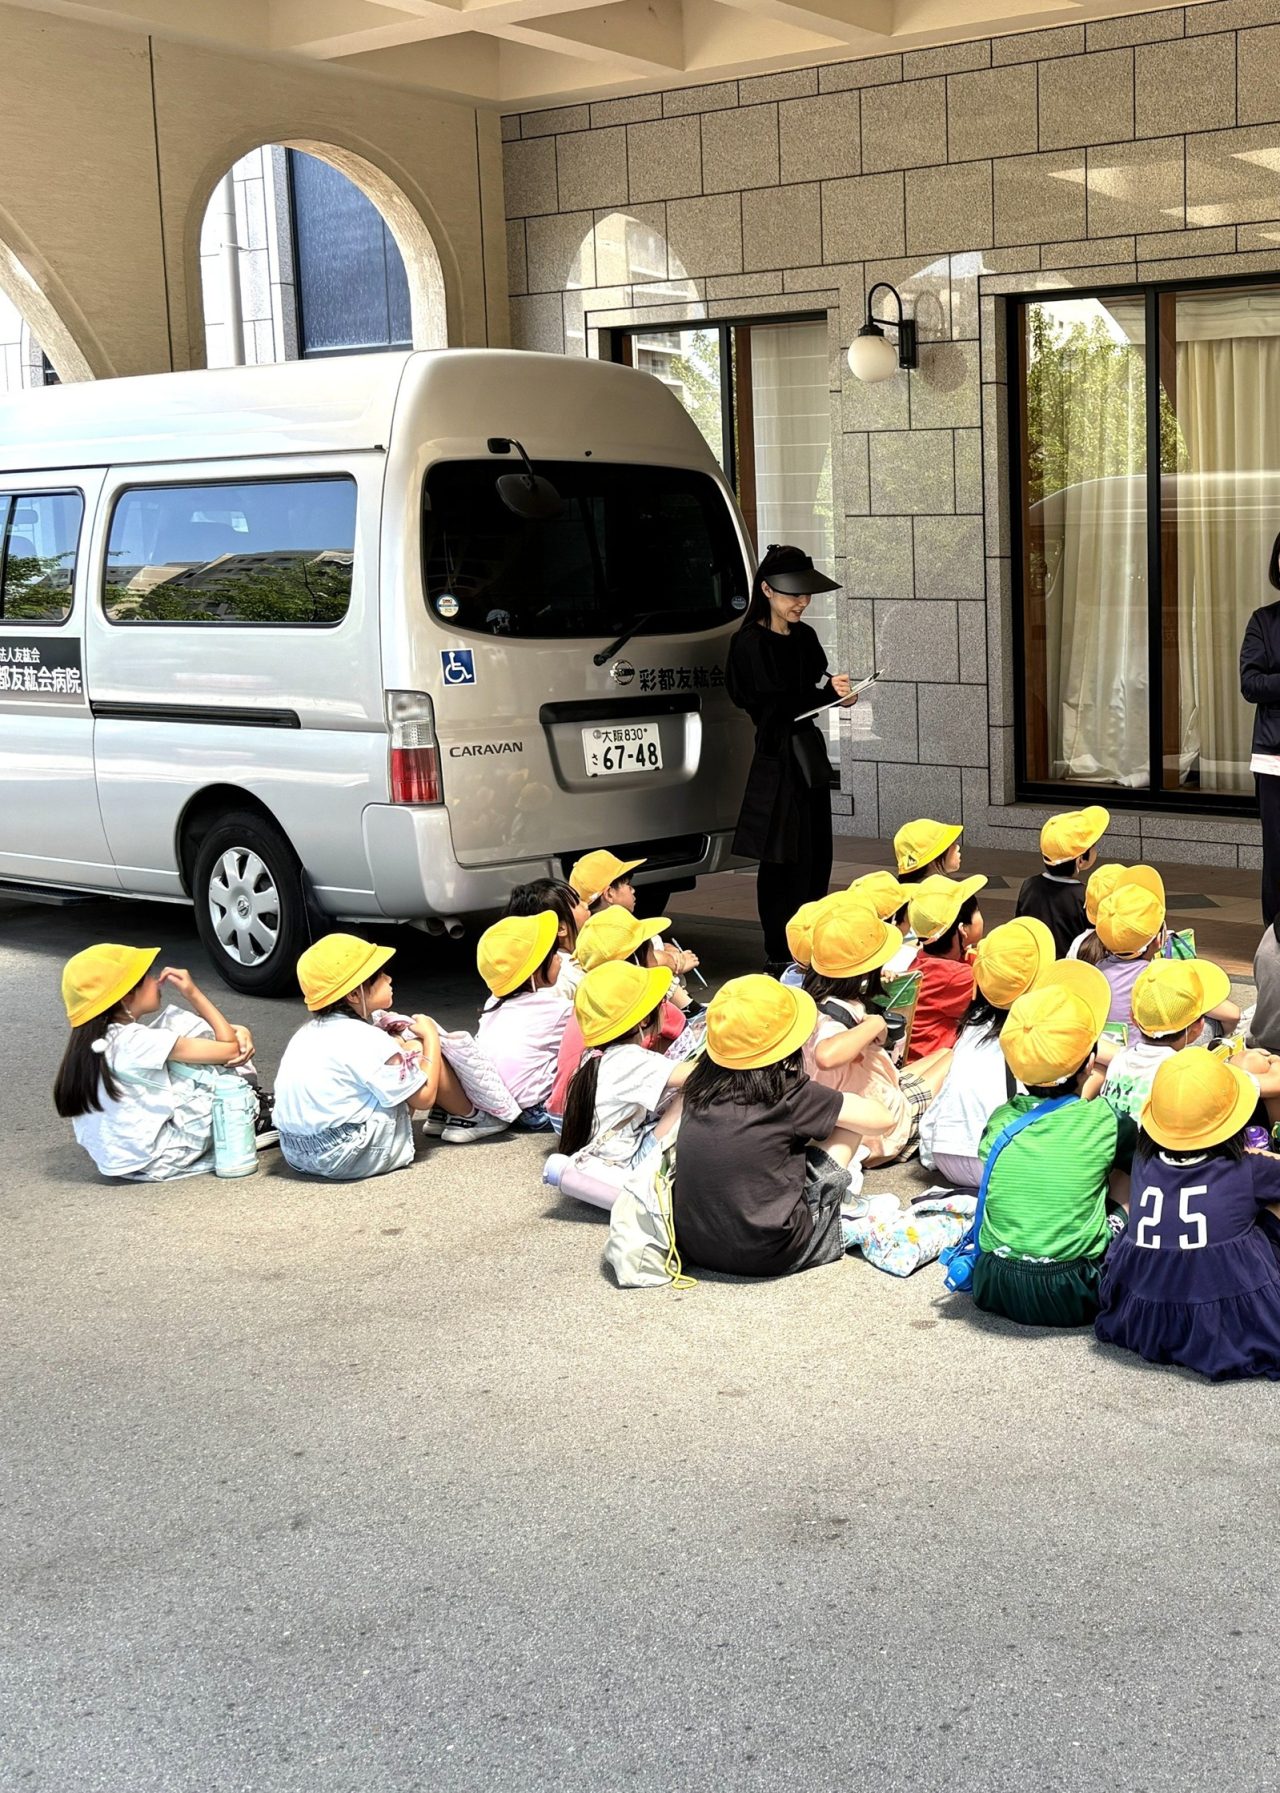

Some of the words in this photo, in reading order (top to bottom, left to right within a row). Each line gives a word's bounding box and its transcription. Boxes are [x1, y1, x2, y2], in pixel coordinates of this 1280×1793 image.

[449, 741, 523, 758] CARAVAN
[591, 753, 599, 765] さ
[603, 742, 659, 770] 67-48
[1135, 1184, 1208, 1250] 25
